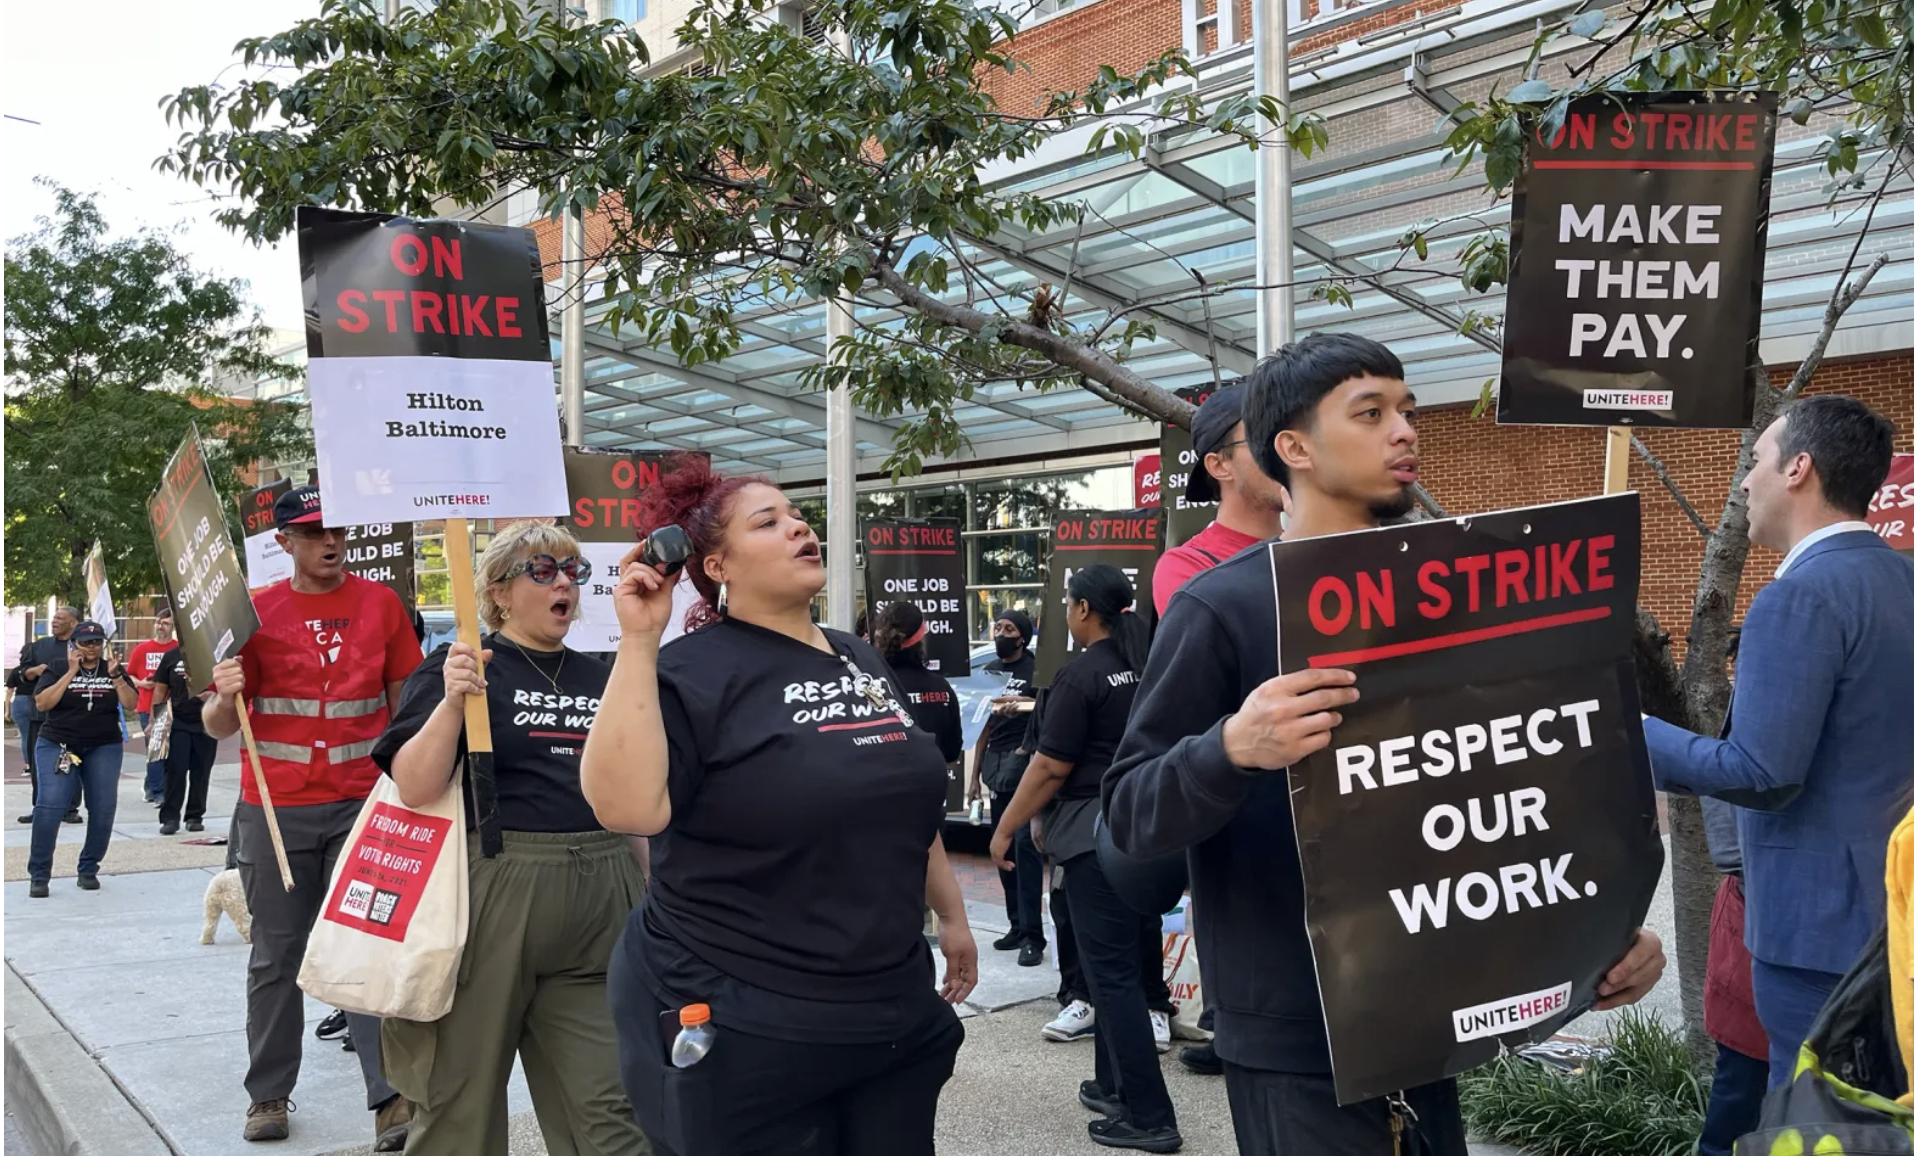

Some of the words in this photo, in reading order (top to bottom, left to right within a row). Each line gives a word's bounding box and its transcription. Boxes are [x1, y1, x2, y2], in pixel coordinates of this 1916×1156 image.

[1610, 113, 1758, 150] STRIKE
[1558, 203, 1722, 244] MAKE
[390, 233, 464, 281] ON
[1555, 259, 1720, 300] THEM
[336, 289, 523, 338] STRIKE
[1569, 313, 1694, 360] PAY.
[406, 392, 484, 412] Hilton
[1586, 393, 1669, 406] UNITEHERE!
[385, 420, 507, 439] Baltimore
[611, 460, 660, 490] ON
[256, 489, 274, 507] ON
[413, 494, 490, 507] UNITEHERE!
[247, 508, 274, 530] STRI
[573, 497, 642, 528] STR
[361, 522, 393, 539] JOB
[868, 527, 894, 545] ON
[899, 527, 956, 546] STRIKE
[1057, 520, 1084, 541] ON
[1088, 518, 1159, 540] STRIKE
[177, 541, 195, 575] ONE
[193, 516, 211, 550] JOB
[382, 541, 404, 558] BE
[177, 554, 210, 609] SHOULD
[208, 533, 226, 563] BE
[884, 579, 918, 593] ONE
[921, 578, 949, 593] JOB
[1308, 568, 1395, 636] ON
[1417, 534, 1616, 620] STRIKE
[189, 569, 229, 631] ENOUGH.
[940, 599, 960, 613] BE
[513, 689, 600, 713] RESPEC
[907, 691, 950, 704] TEHERE!
[513, 711, 557, 727] OUR
[565, 714, 595, 730] WO
[792, 702, 846, 724] OUR
[1335, 699, 1600, 795] RESPECT
[1421, 786, 1550, 851] OUR
[409, 826, 436, 844] RIDE
[381, 852, 422, 875] RIGHTS
[1388, 852, 1598, 934] WORK.
[1459, 989, 1568, 1035] UNITEHERE!
